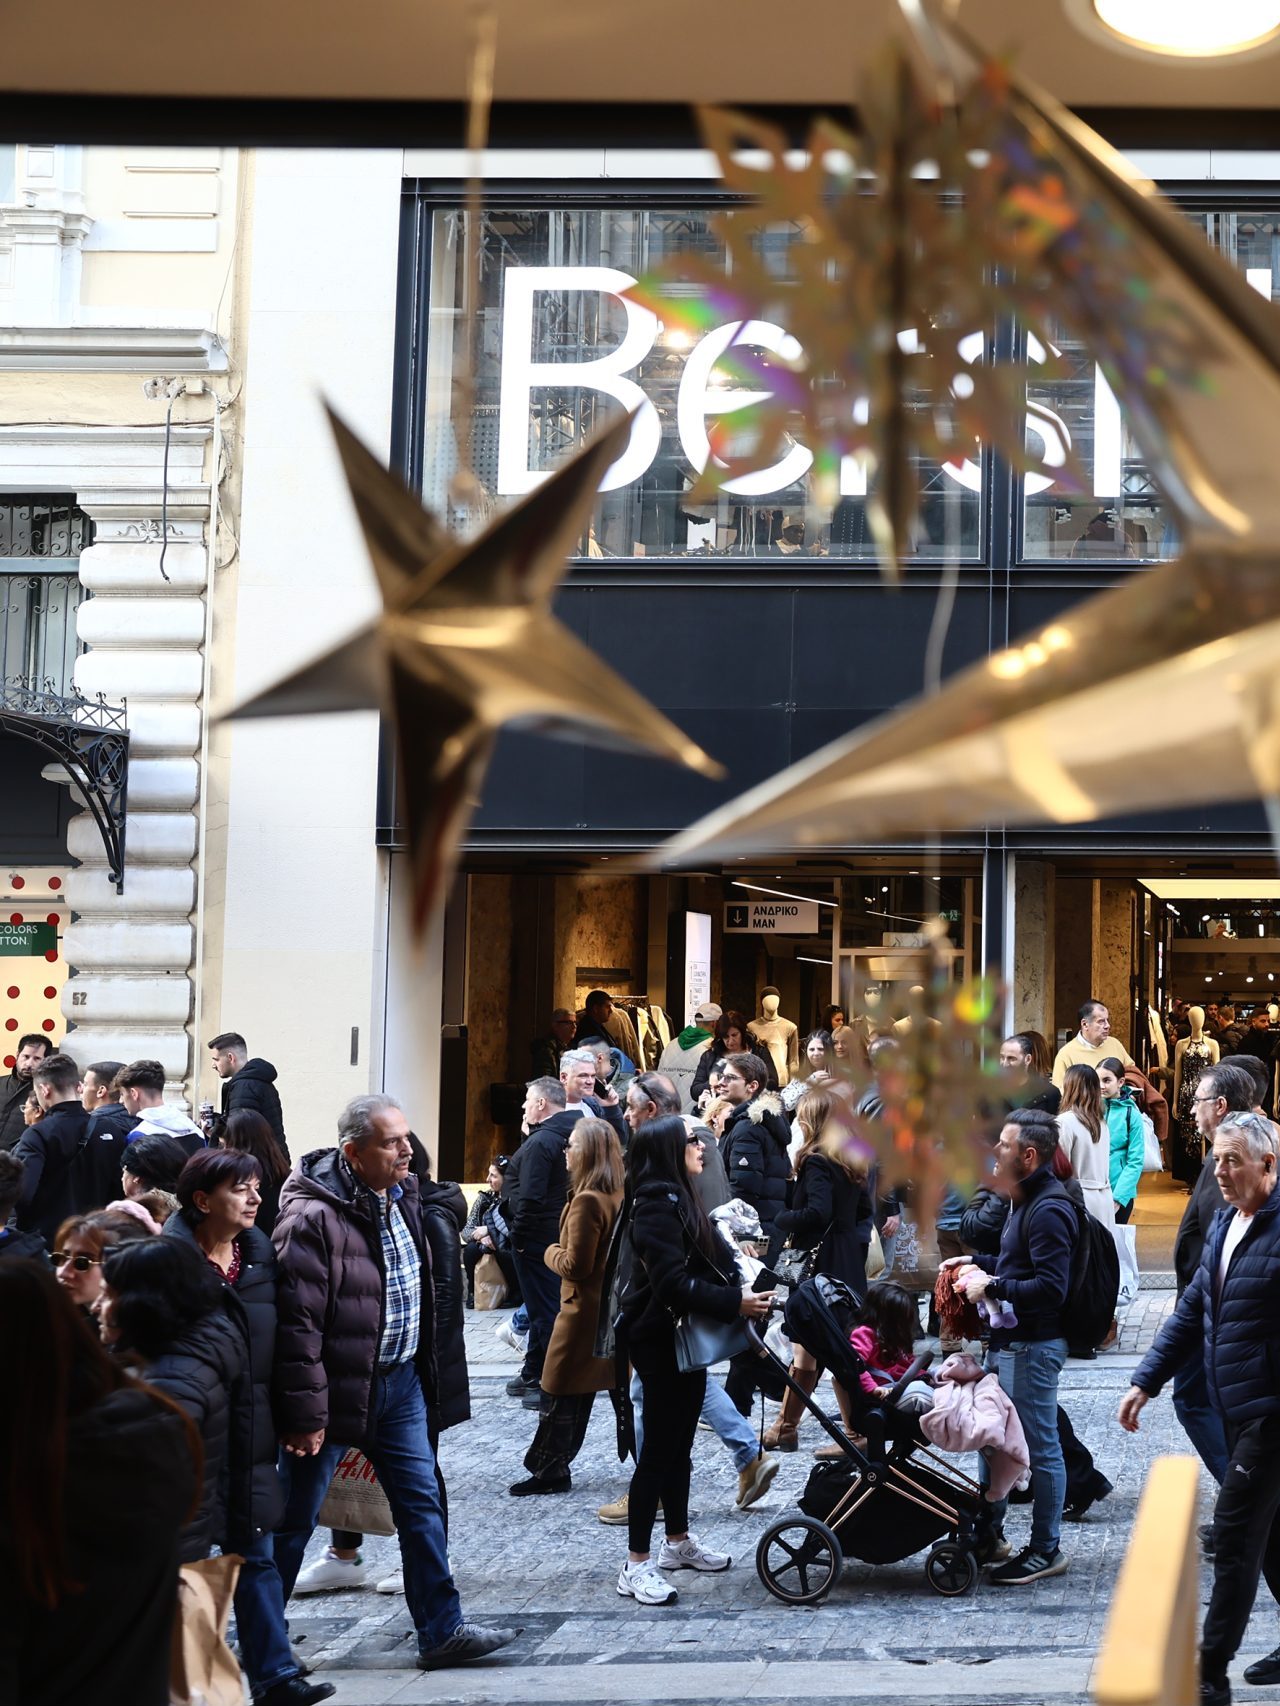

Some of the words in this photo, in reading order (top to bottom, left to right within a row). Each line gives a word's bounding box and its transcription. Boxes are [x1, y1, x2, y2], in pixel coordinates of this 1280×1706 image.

[753, 906, 798, 916] ΑΝΔΡΙΚΟ
[752, 918, 776, 929] MAN
[72, 992, 88, 1006] 52
